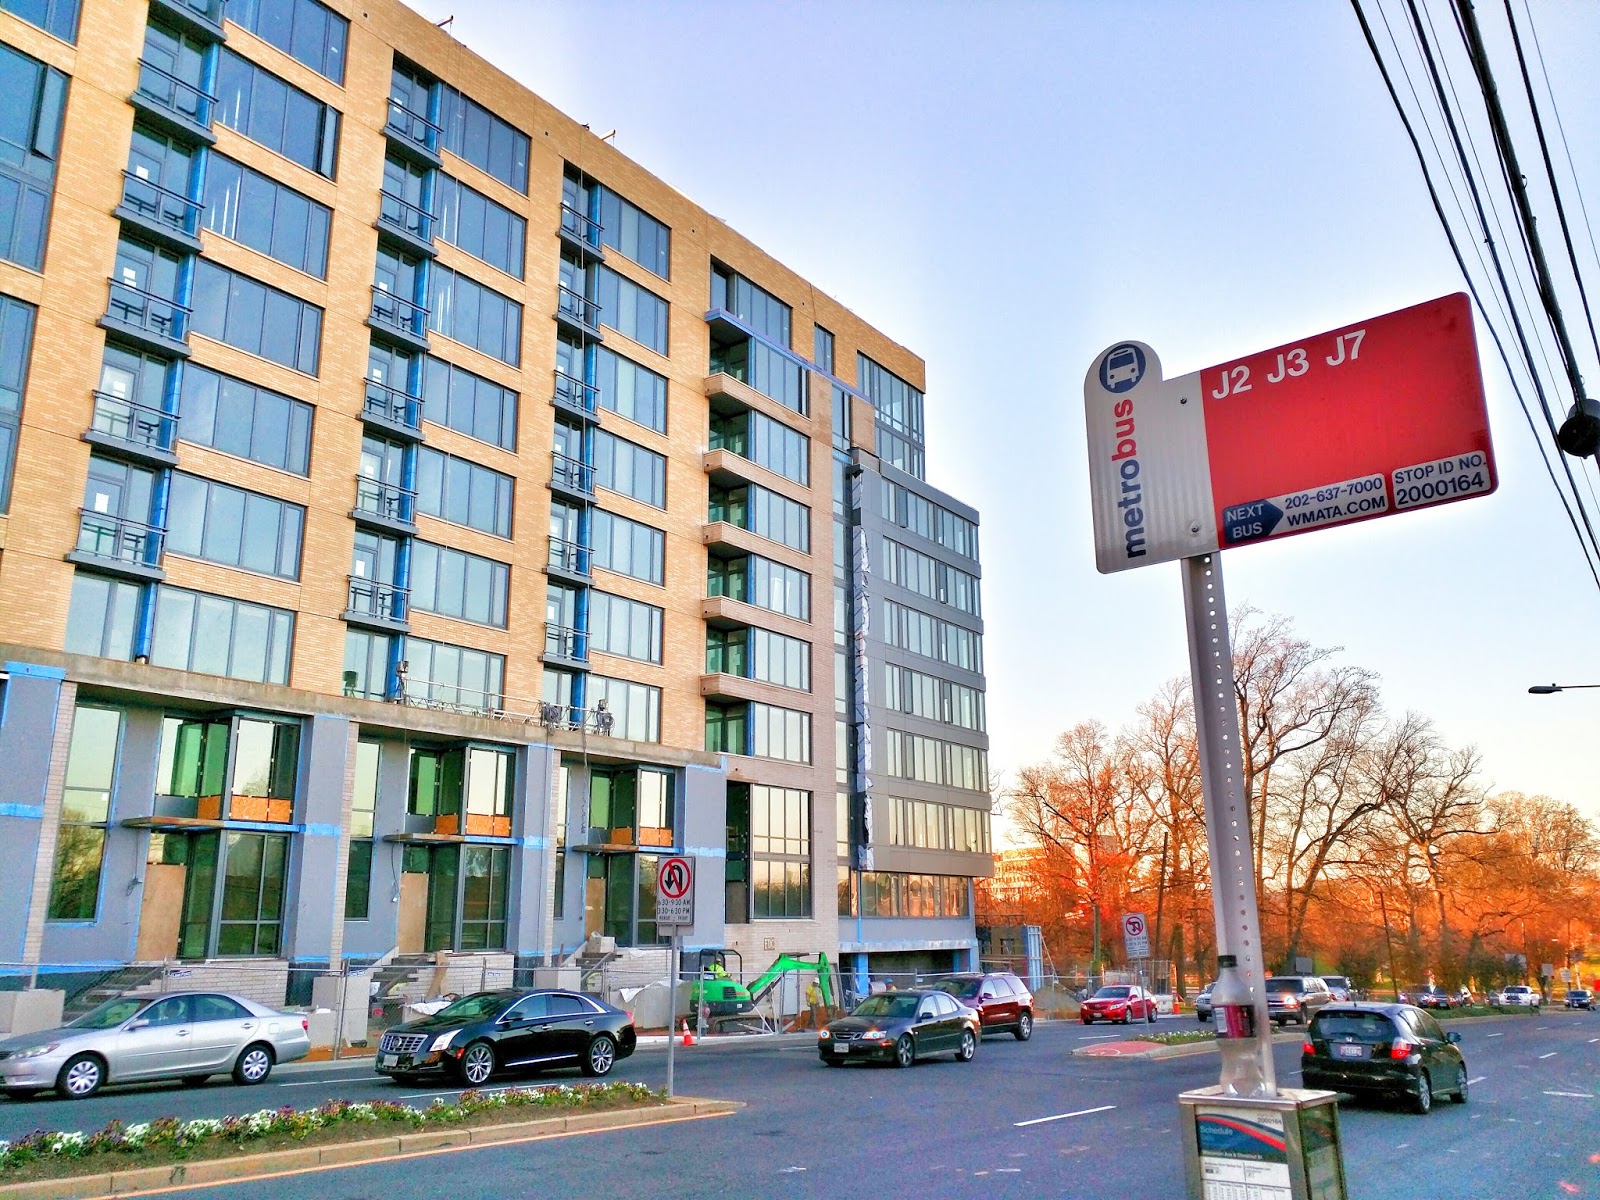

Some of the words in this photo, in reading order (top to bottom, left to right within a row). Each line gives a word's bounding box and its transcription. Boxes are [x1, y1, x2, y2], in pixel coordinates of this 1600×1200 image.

[1212, 365, 1252, 399] J2
[1267, 348, 1310, 383] J3
[1326, 329, 1366, 366] J7
[1111, 399, 1147, 558] metrobus
[1395, 465, 1434, 484] STOP
[1438, 461, 1454, 474] ID
[1459, 454, 1487, 470] NO.
[1285, 477, 1383, 510] 202-637-7000
[1396, 472, 1484, 505] 2000164
[1226, 503, 1264, 522] NEXT
[1287, 495, 1386, 527] WMATA.COM
[1232, 522, 1263, 539] BUS
